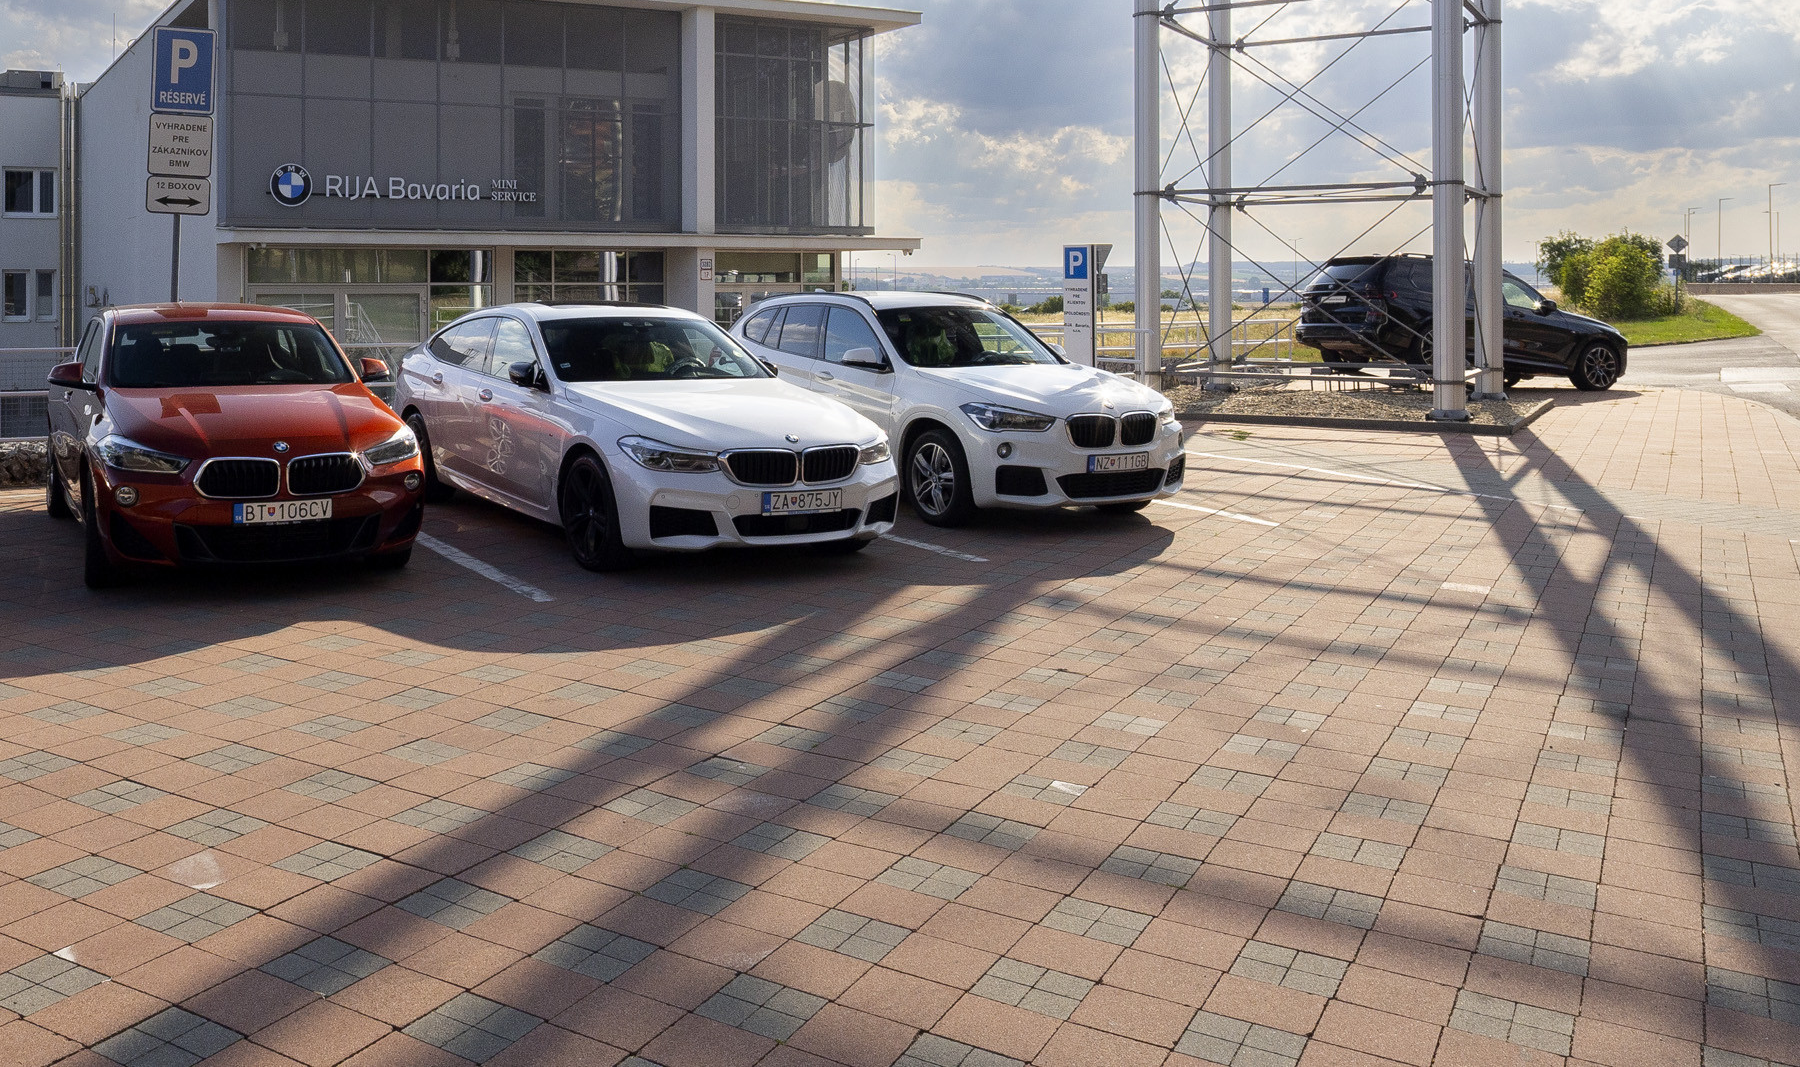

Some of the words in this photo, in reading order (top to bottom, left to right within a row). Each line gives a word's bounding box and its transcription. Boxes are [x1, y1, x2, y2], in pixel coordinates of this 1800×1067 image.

[171, 38, 198, 83] P
[159, 89, 206, 105] RÉSERVÉ
[172, 135, 189, 144] PRE
[152, 145, 209, 157] ZÁKAZNÍKOV
[169, 159, 190, 168] BMW
[276, 165, 307, 177] BMW
[156, 181, 166, 189] 12
[168, 182, 202, 191] BOXOV
[325, 175, 381, 201] RIJA
[388, 176, 480, 201] Bavaria
[491, 179, 517, 190] MINI
[491, 190, 537, 202] SERVICE
[1069, 251, 1083, 275] P
[1096, 457, 1110, 470] NZ
[1117, 454, 1147, 469] 111GB
[772, 494, 789, 510] ZA
[798, 491, 840, 509] 875JY
[245, 504, 267, 521] BT
[278, 500, 329, 520] 106CV
